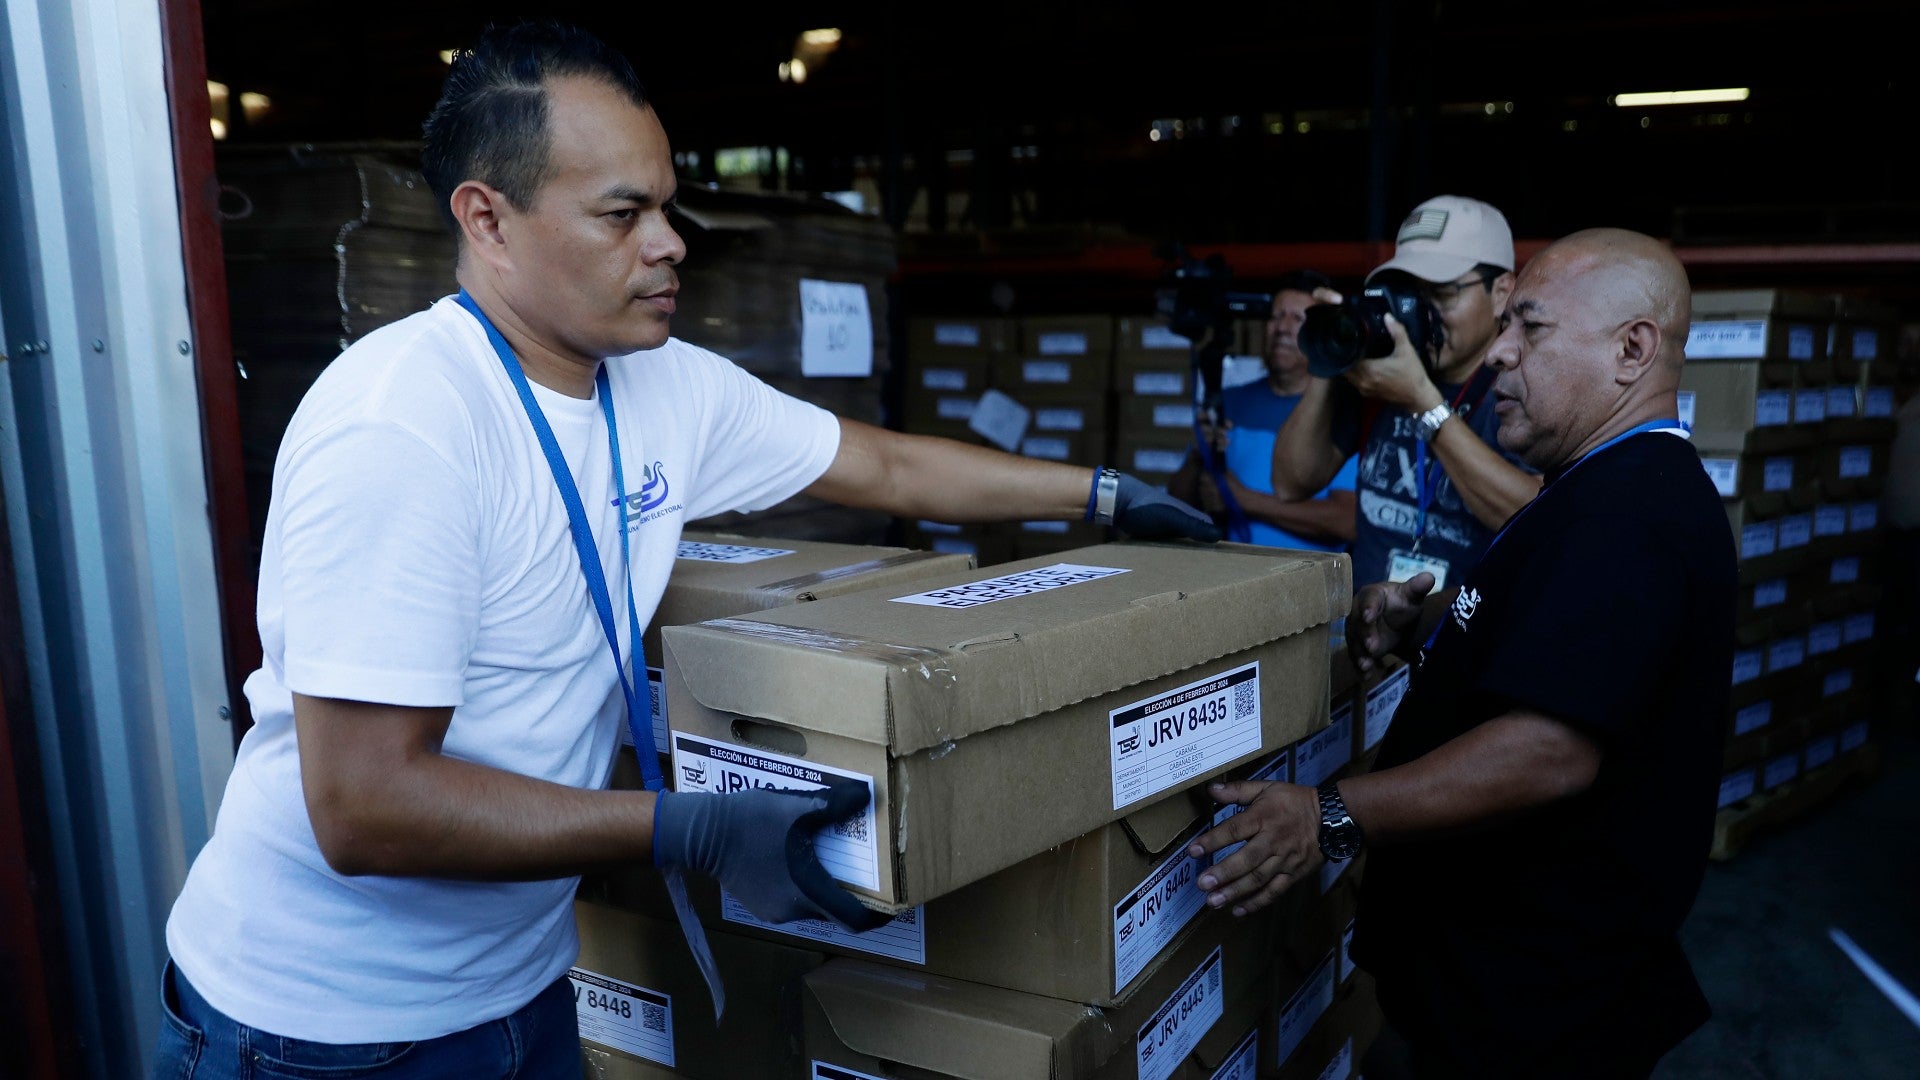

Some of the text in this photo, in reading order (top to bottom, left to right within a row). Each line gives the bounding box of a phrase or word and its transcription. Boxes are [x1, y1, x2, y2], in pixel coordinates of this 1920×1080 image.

[922, 568, 1070, 600] PAQUETE
[938, 570, 1122, 608] ELECTORAL
[1177, 693, 1184, 703] DE
[1185, 684, 1208, 700] FEBRERO
[1209, 681, 1216, 691] DE
[1217, 678, 1227, 688] 2024
[1148, 695, 1226, 748] JRV 8435
[709, 747, 822, 782] ELECCIÓN 4 DE FEBRERO DE 2024
[1139, 860, 1190, 928] JRV 8442
[587, 989, 631, 1019] 8448
[1158, 1008, 1179, 1047] JRV
[1181, 981, 1203, 1022] 8443
